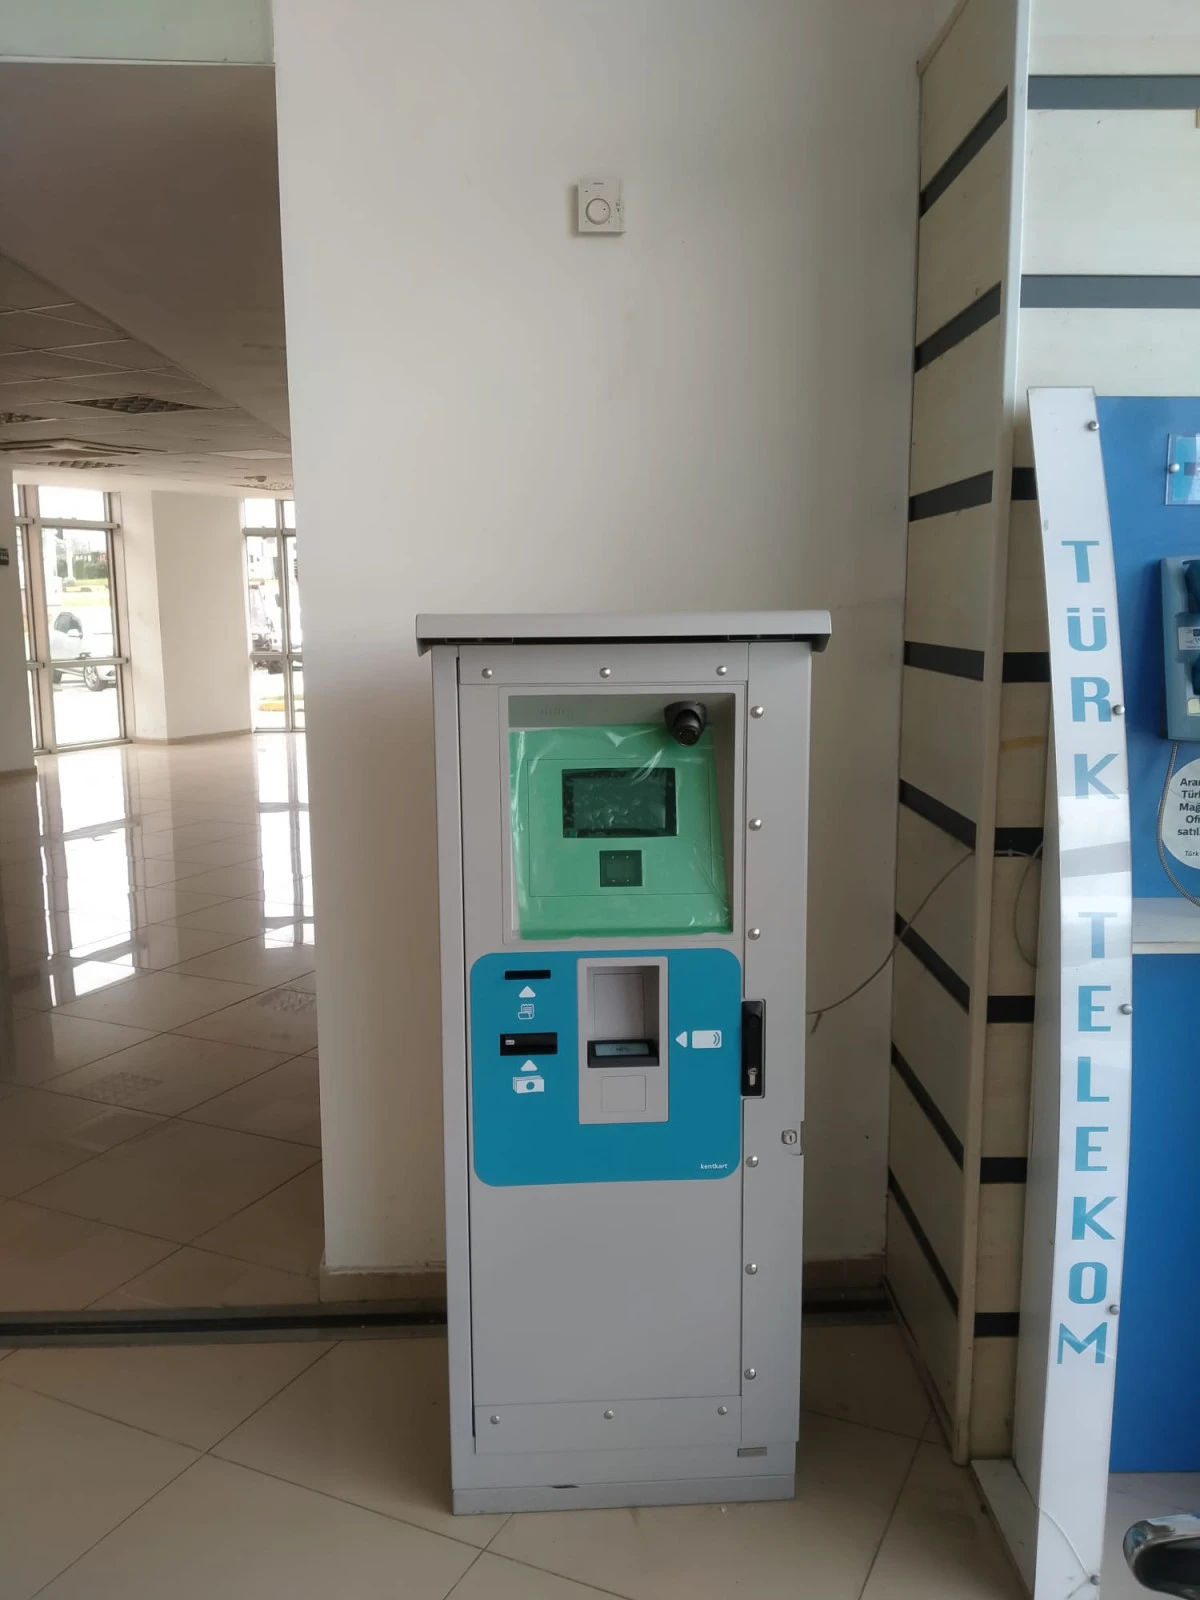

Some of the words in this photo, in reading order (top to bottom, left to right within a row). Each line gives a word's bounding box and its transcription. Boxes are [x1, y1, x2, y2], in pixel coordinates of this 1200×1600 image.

[1060, 540, 1121, 800] TÜRK
[1177, 827, 1200, 835] satıl
[1056, 911, 1118, 1365] TELEKOM
